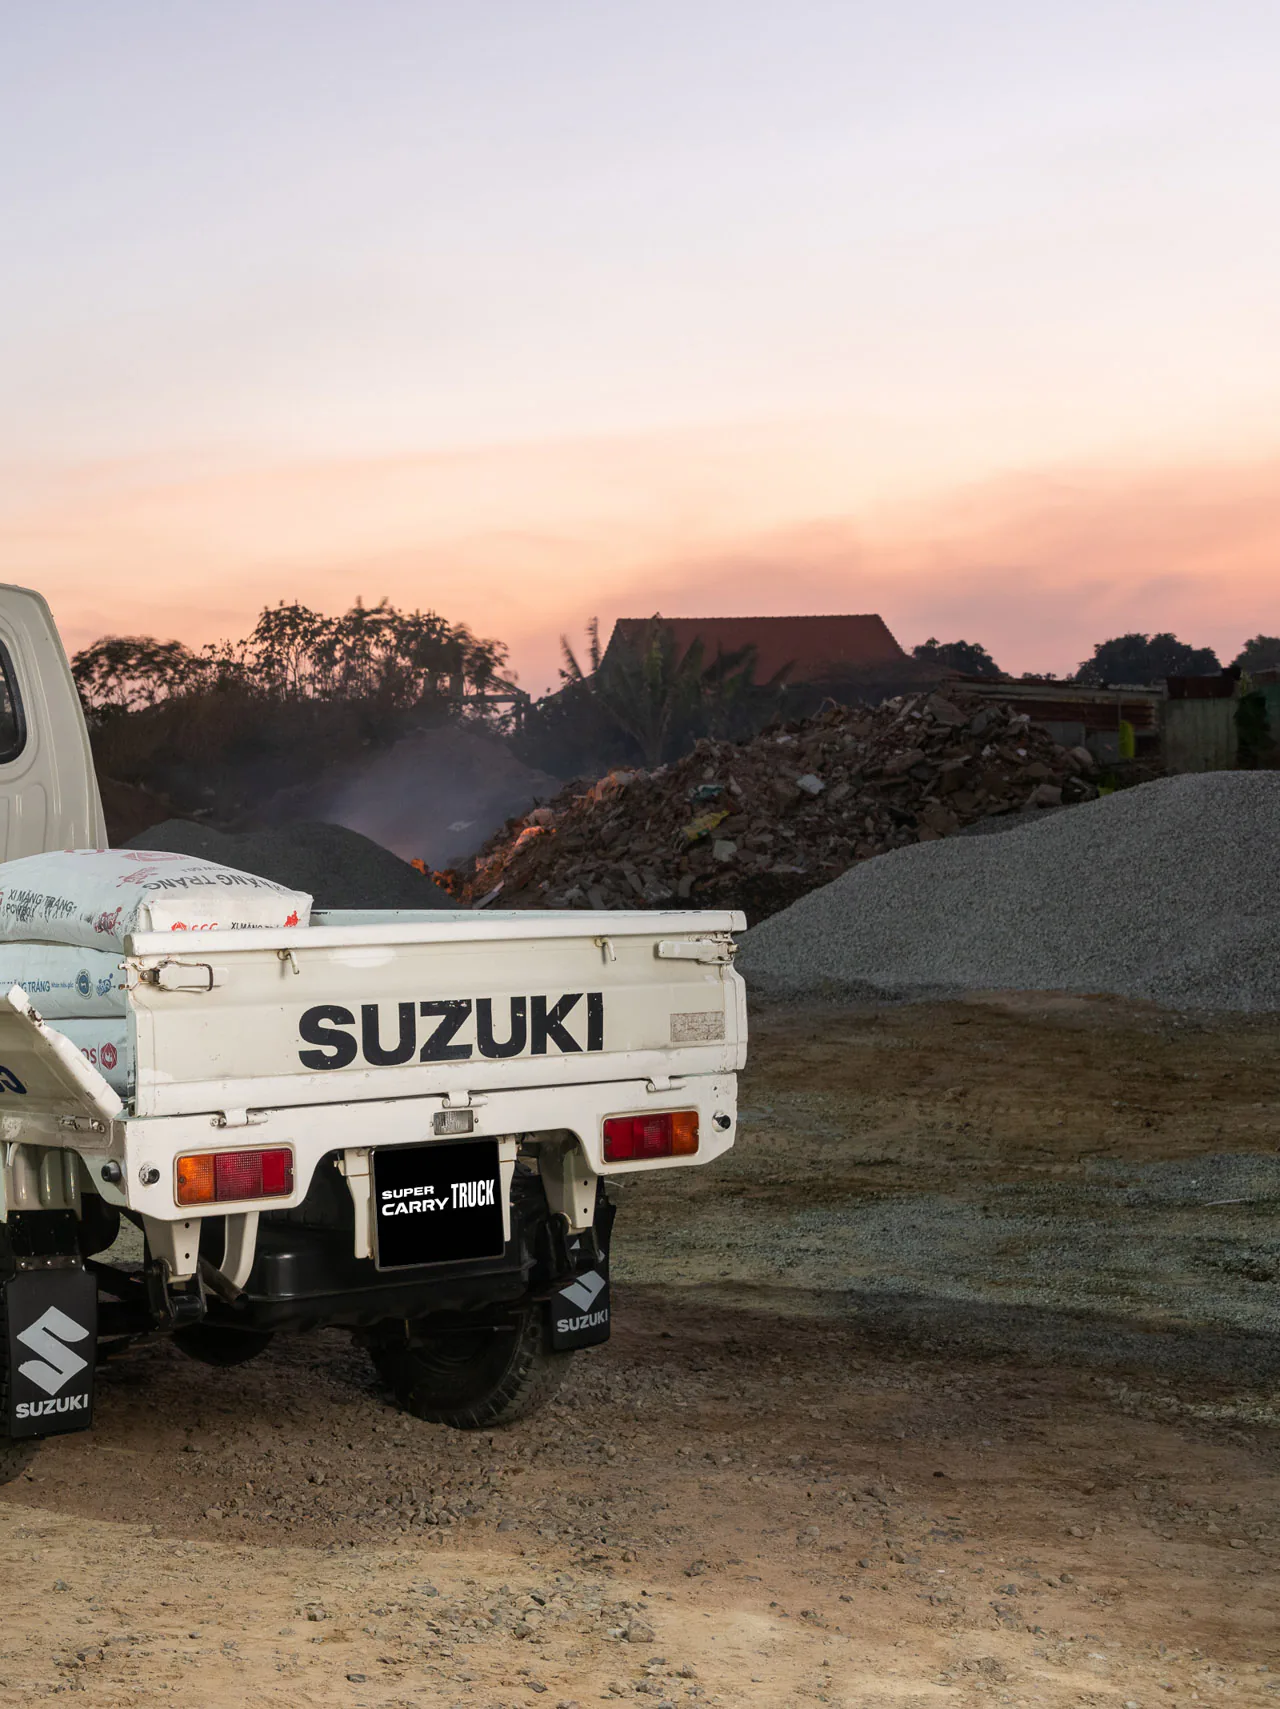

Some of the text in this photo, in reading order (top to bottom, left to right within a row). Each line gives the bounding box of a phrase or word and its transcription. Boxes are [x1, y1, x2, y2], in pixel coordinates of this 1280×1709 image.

[298, 991, 604, 1071] SUZUKI
[381, 1185, 435, 1200] SUPER
[381, 1179, 496, 1217] CARRY TRUCK
[557, 1308, 609, 1334] SUZUKI
[15, 1393, 89, 1419] SUZUKI
